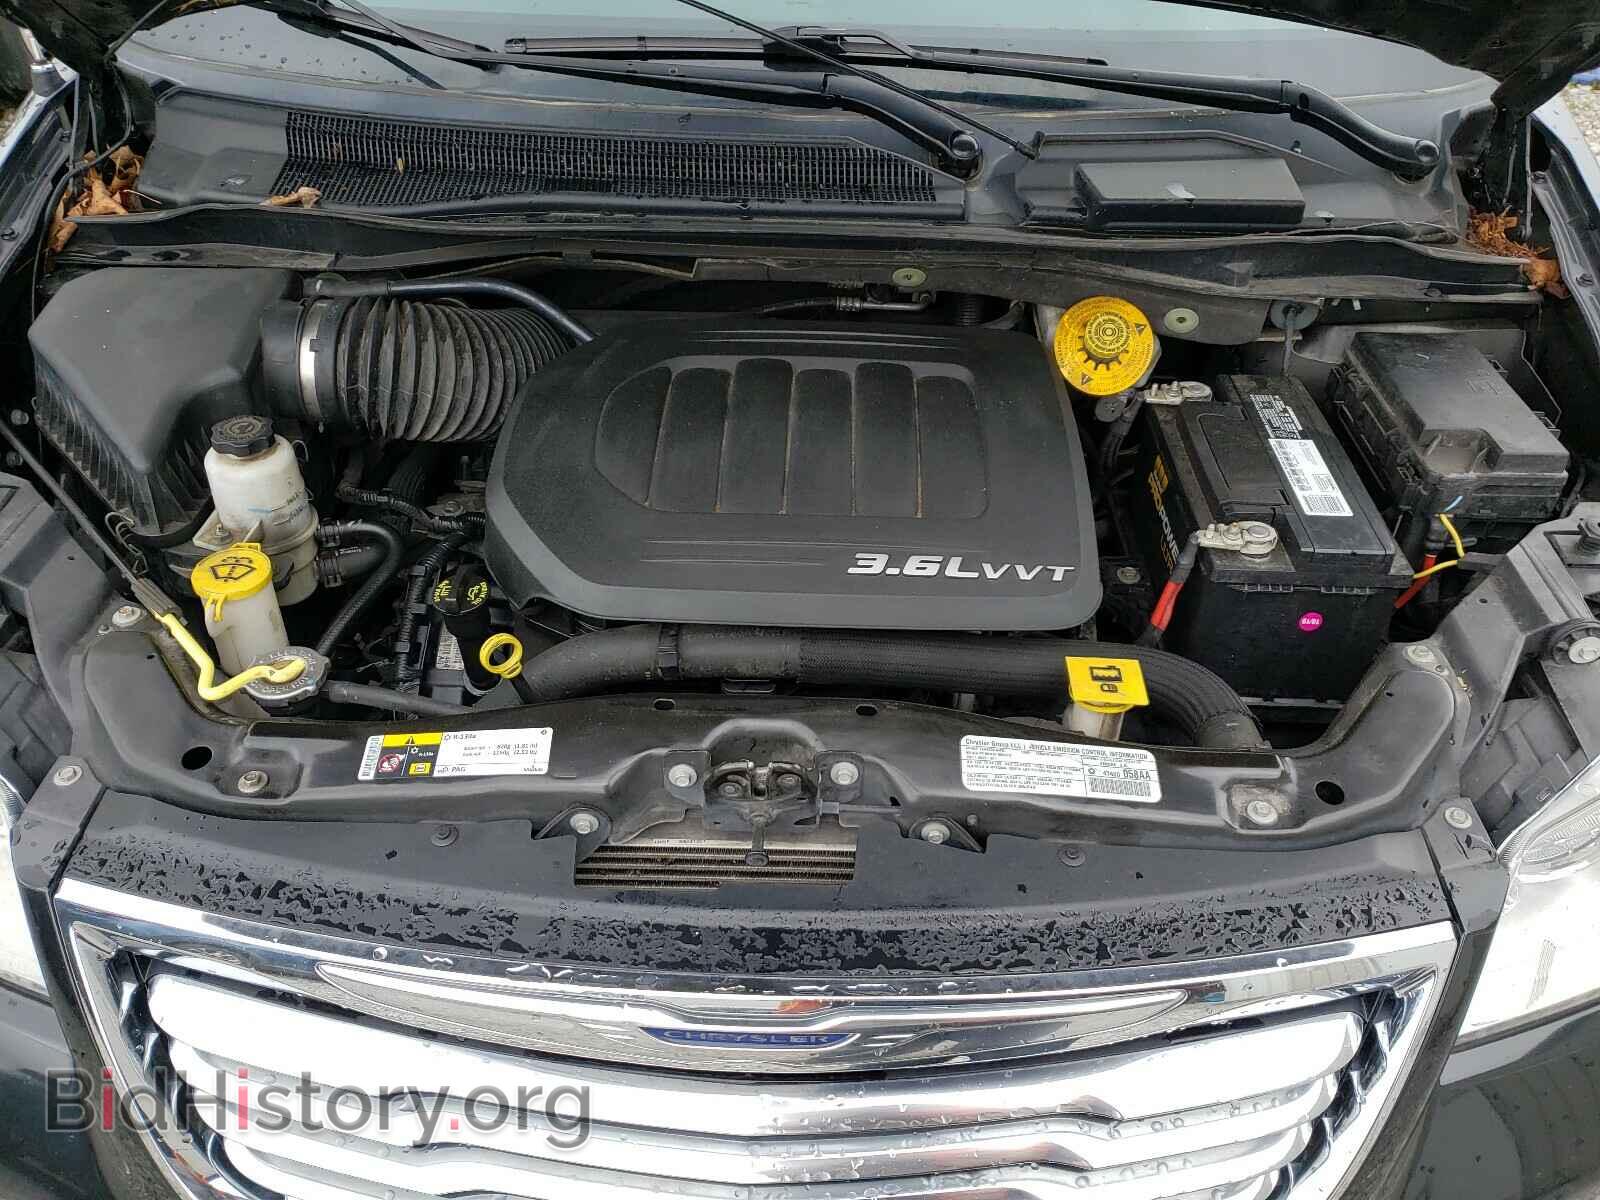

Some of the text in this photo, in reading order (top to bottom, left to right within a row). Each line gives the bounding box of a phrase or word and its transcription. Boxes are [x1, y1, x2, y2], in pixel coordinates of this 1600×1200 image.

[1081, 748, 1107, 756] CONTROL
[1109, 751, 1148, 760] INFORMATION
[663, 1030, 829, 1044] CHRYSLER
